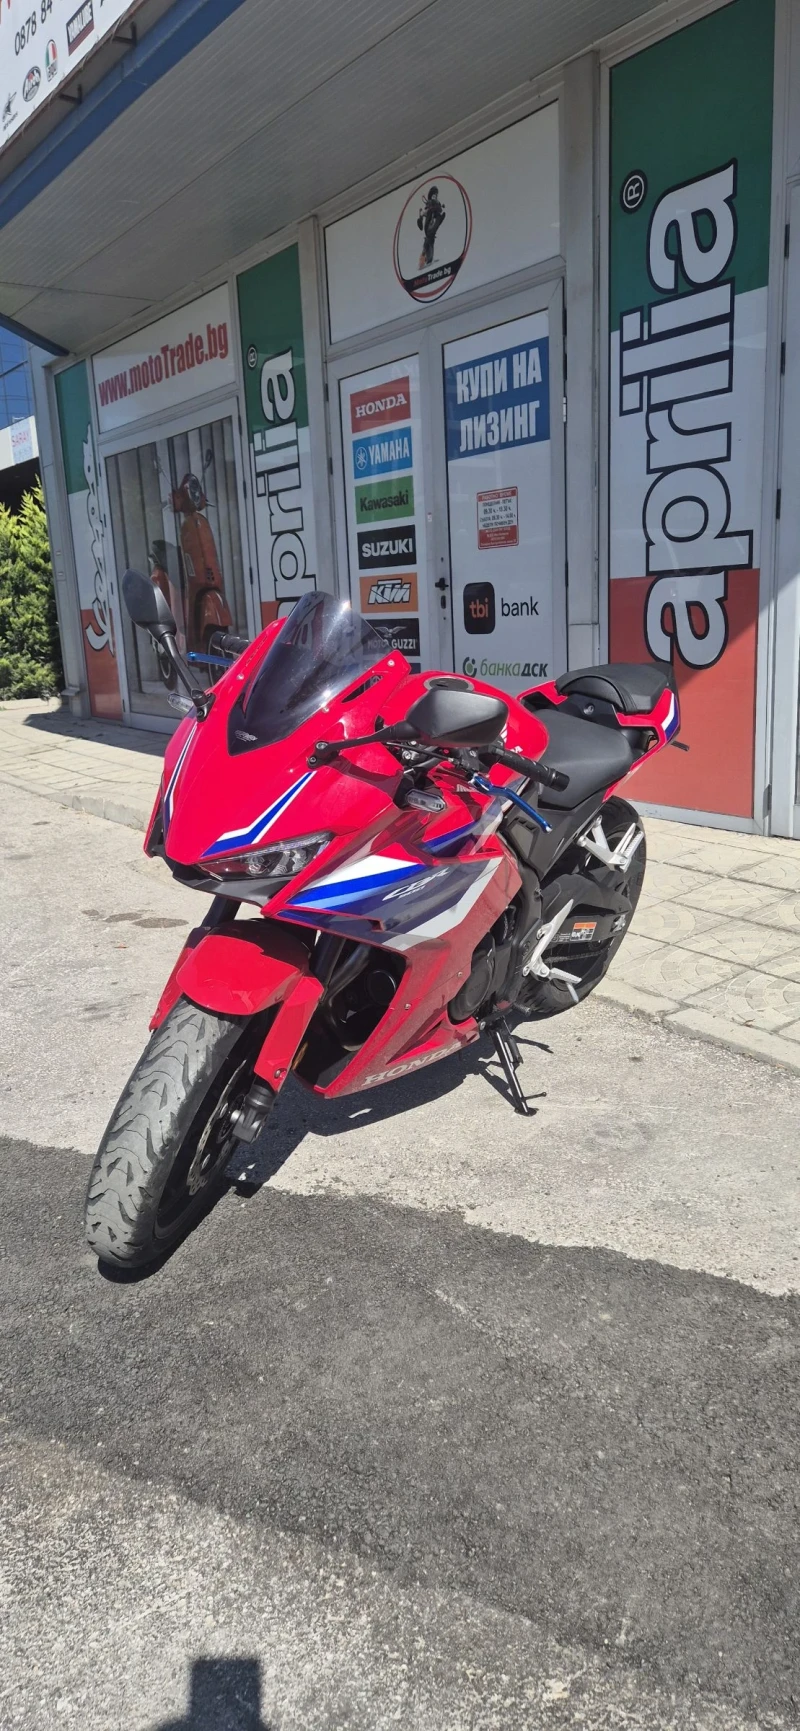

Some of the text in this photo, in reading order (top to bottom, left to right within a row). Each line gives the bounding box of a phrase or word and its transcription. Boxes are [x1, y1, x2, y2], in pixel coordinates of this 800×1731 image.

[15, 10, 37, 56] 0878
[98, 322, 229, 407] www.motoTrade.bg
[456, 347, 542, 405] КУПИ НА
[355, 392, 408, 418] HONDA
[620, 158, 753, 670] aprilia
[459, 400, 540, 453] ЛИЗИНГ
[368, 437, 410, 465] YAMAHA
[360, 490, 409, 512] Kawasaki
[362, 537, 413, 558] SUZUKI
[368, 578, 412, 606] KTM
[469, 596, 539, 618] tbi bank
[391, 638, 416, 650] GUZZI
[361, 1041, 462, 1087] HONDA
